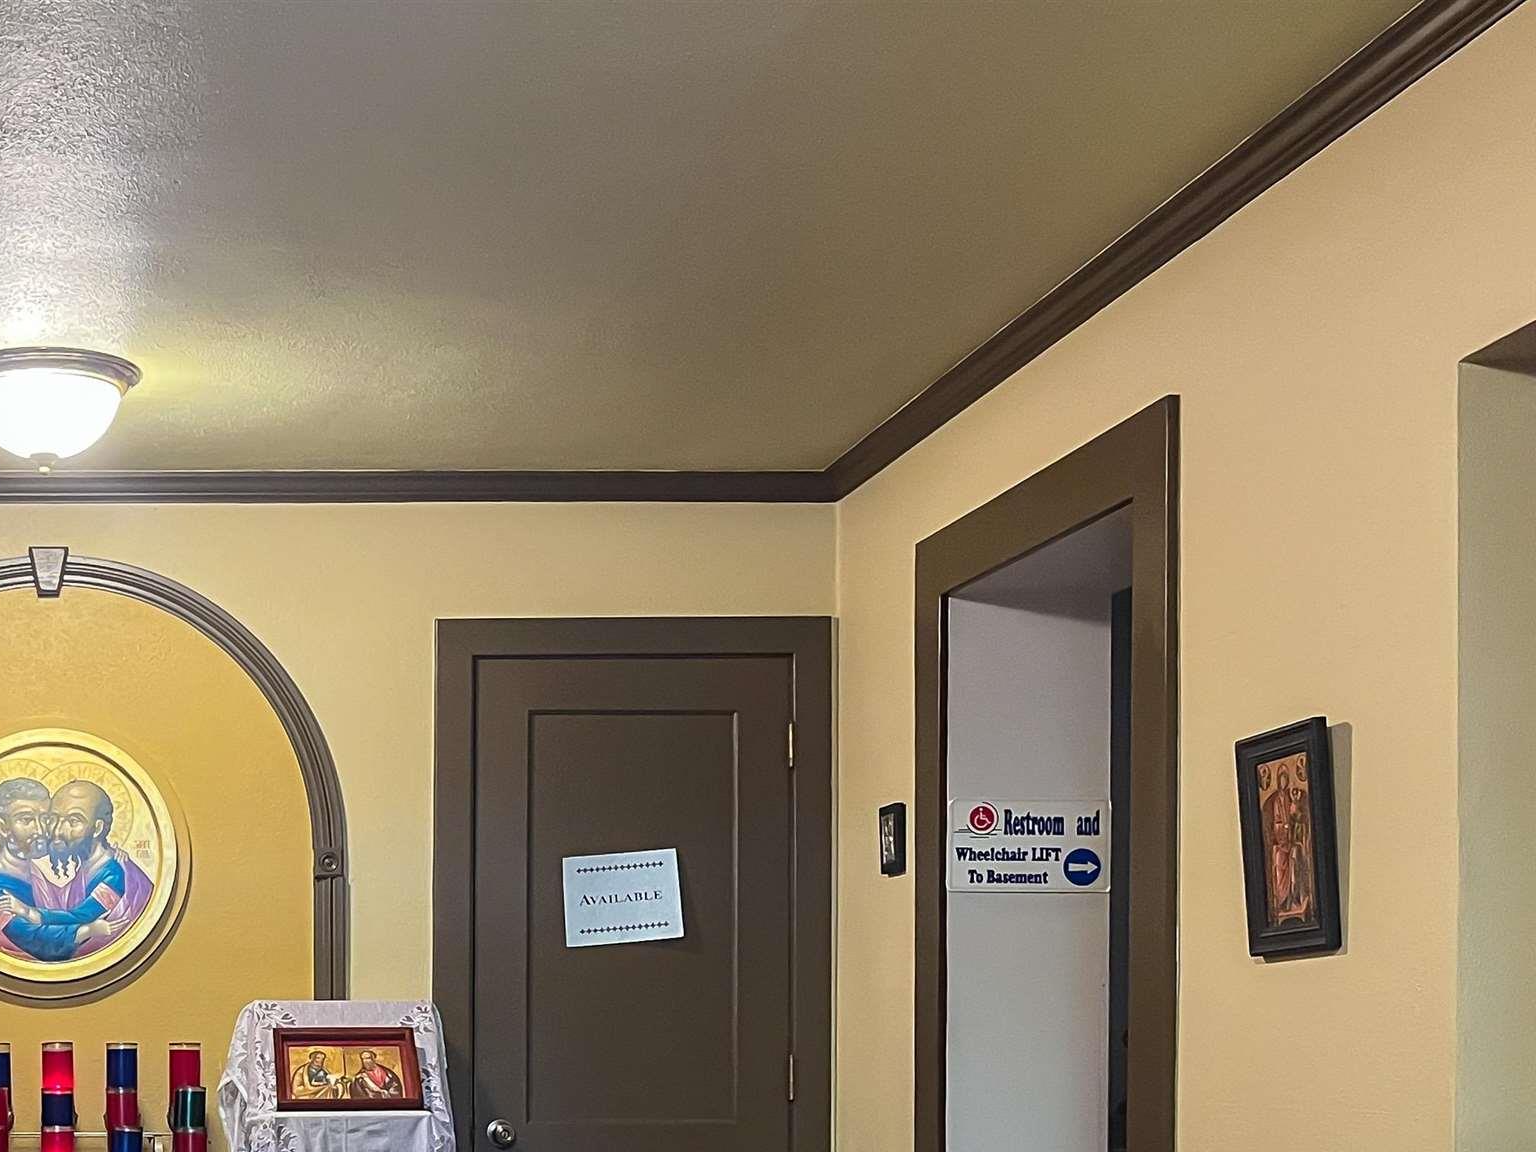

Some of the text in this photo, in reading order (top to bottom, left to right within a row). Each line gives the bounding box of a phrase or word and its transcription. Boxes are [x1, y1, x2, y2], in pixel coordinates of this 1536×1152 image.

[1003, 808, 1101, 836] Restroom and
[955, 847, 1062, 862] Wheelchair LIFT
[968, 869, 1049, 884] To Basement
[579, 890, 663, 907] AVAILABLE
